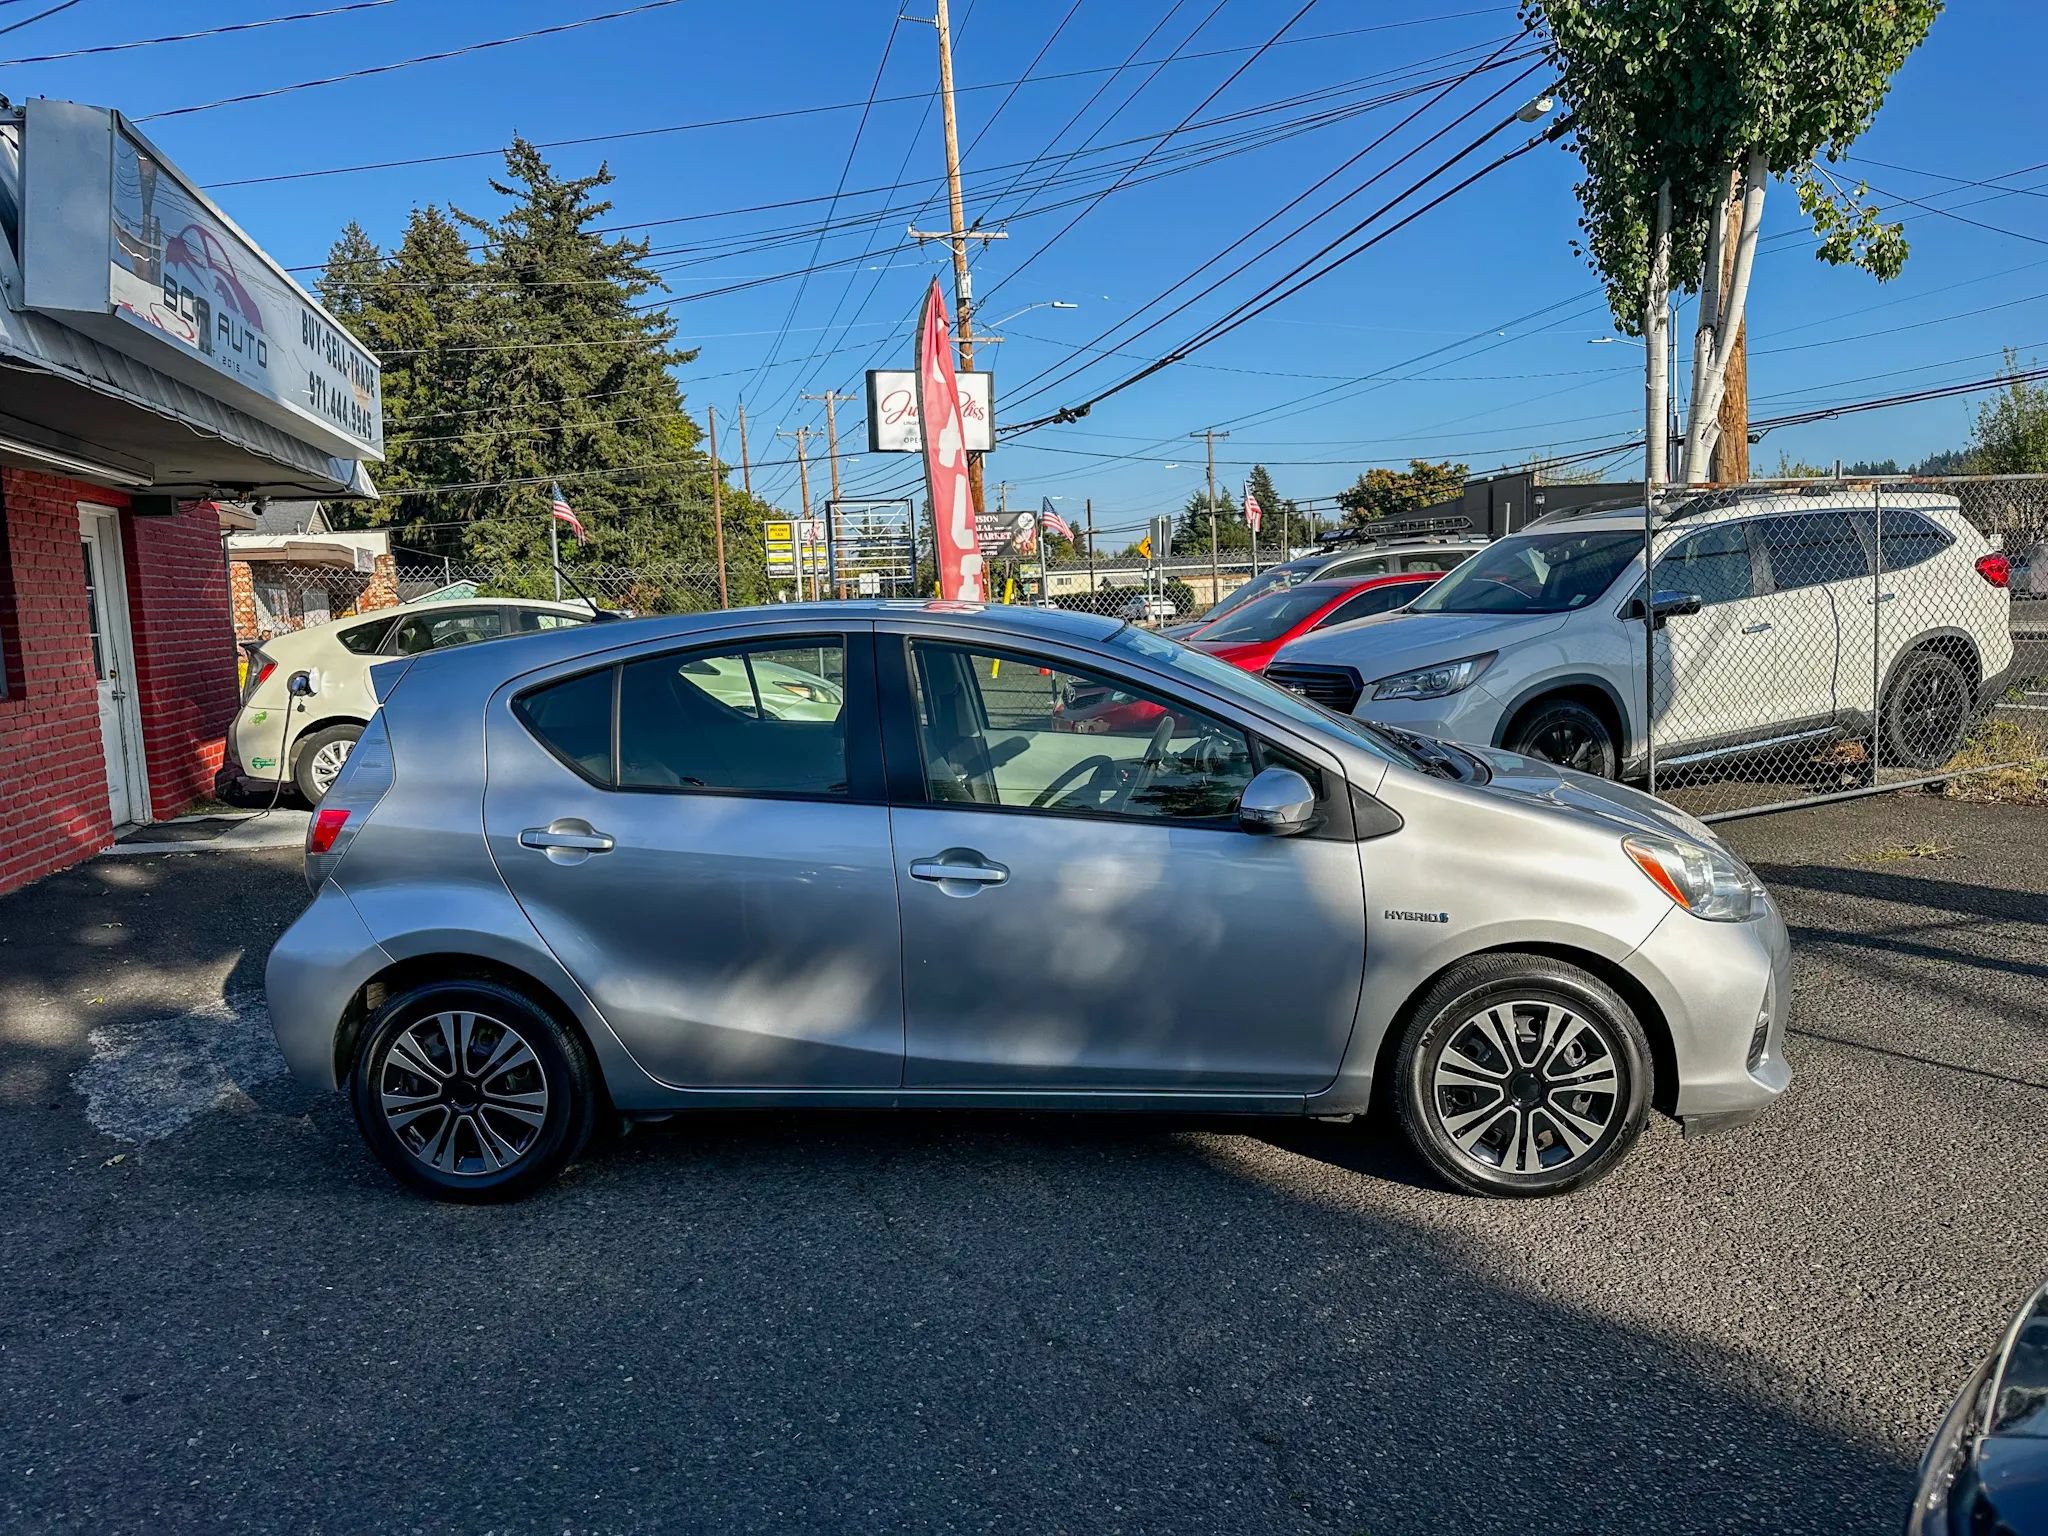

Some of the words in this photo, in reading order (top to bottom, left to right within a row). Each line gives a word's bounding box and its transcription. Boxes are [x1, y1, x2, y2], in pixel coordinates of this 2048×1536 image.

[218, 312, 267, 368] AUTO
[309, 370, 372, 441] 971.444.9945
[881, 390, 919, 425] Ju
[1384, 910, 1439, 923] HYBRID
